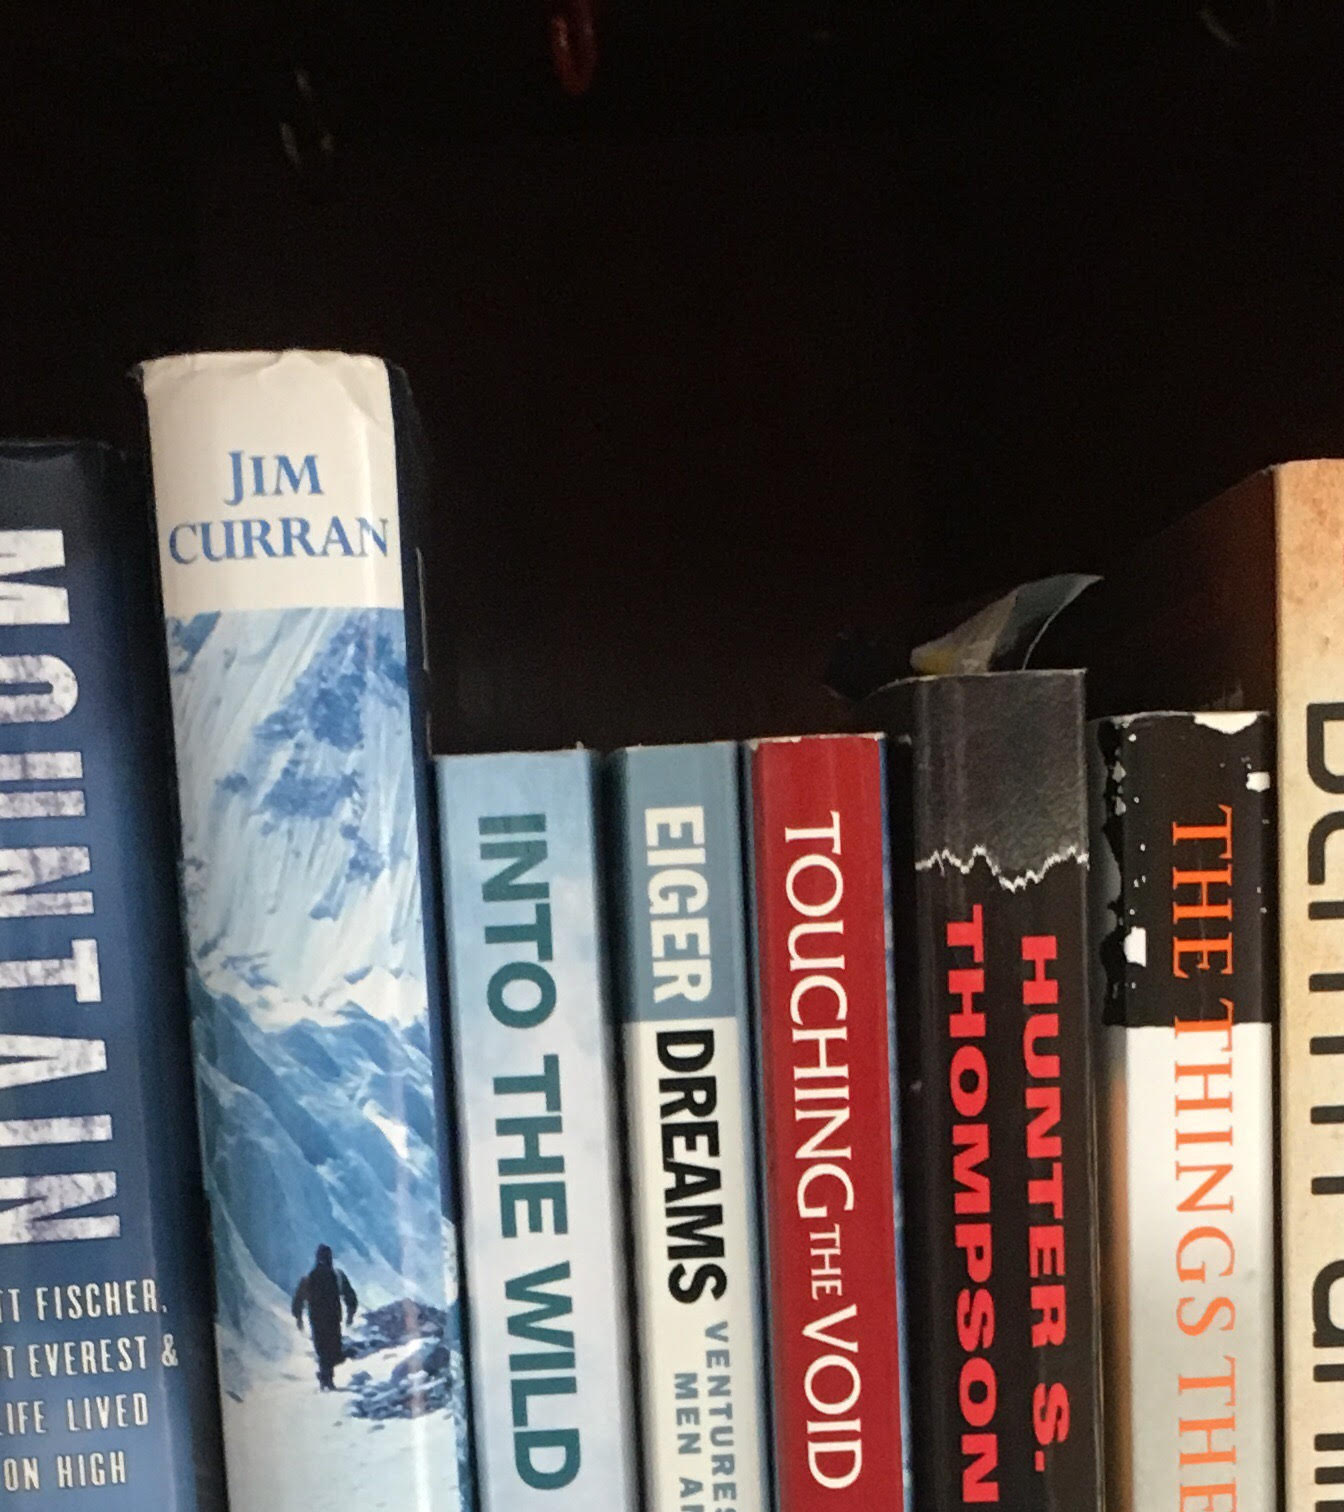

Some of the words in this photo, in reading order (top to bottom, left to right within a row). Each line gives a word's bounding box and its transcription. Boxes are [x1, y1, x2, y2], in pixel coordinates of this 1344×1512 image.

[168, 516, 389, 565] CURRAN
[223, 451, 324, 506] JIM
[478, 813, 557, 1030] INTO
[645, 806, 712, 1003] EIGER
[1171, 805, 1233, 980] THE
[784, 811, 854, 1218] TOUCHING
[493, 1054, 568, 1239] THE
[657, 1029, 728, 1304] DREAMS
[945, 903, 999, 1504] THOMPSON
[1021, 934, 1066, 1349] HUNTER
[1174, 999, 1235, 1336] THINGS
[809, 1223, 841, 1300] THE
[29, 1336, 146, 1378] EVEREST
[161, 1333, 179, 1368] &
[66, 1391, 150, 1429] LIVED
[503, 1259, 581, 1491] WILD
[674, 1372, 702, 1455] MEN
[801, 1304, 864, 1490] VOID
[1033, 1382, 1070, 1473] S.
[4, 1457, 39, 1491] ON
[57, 1450, 126, 1487] HIGH
